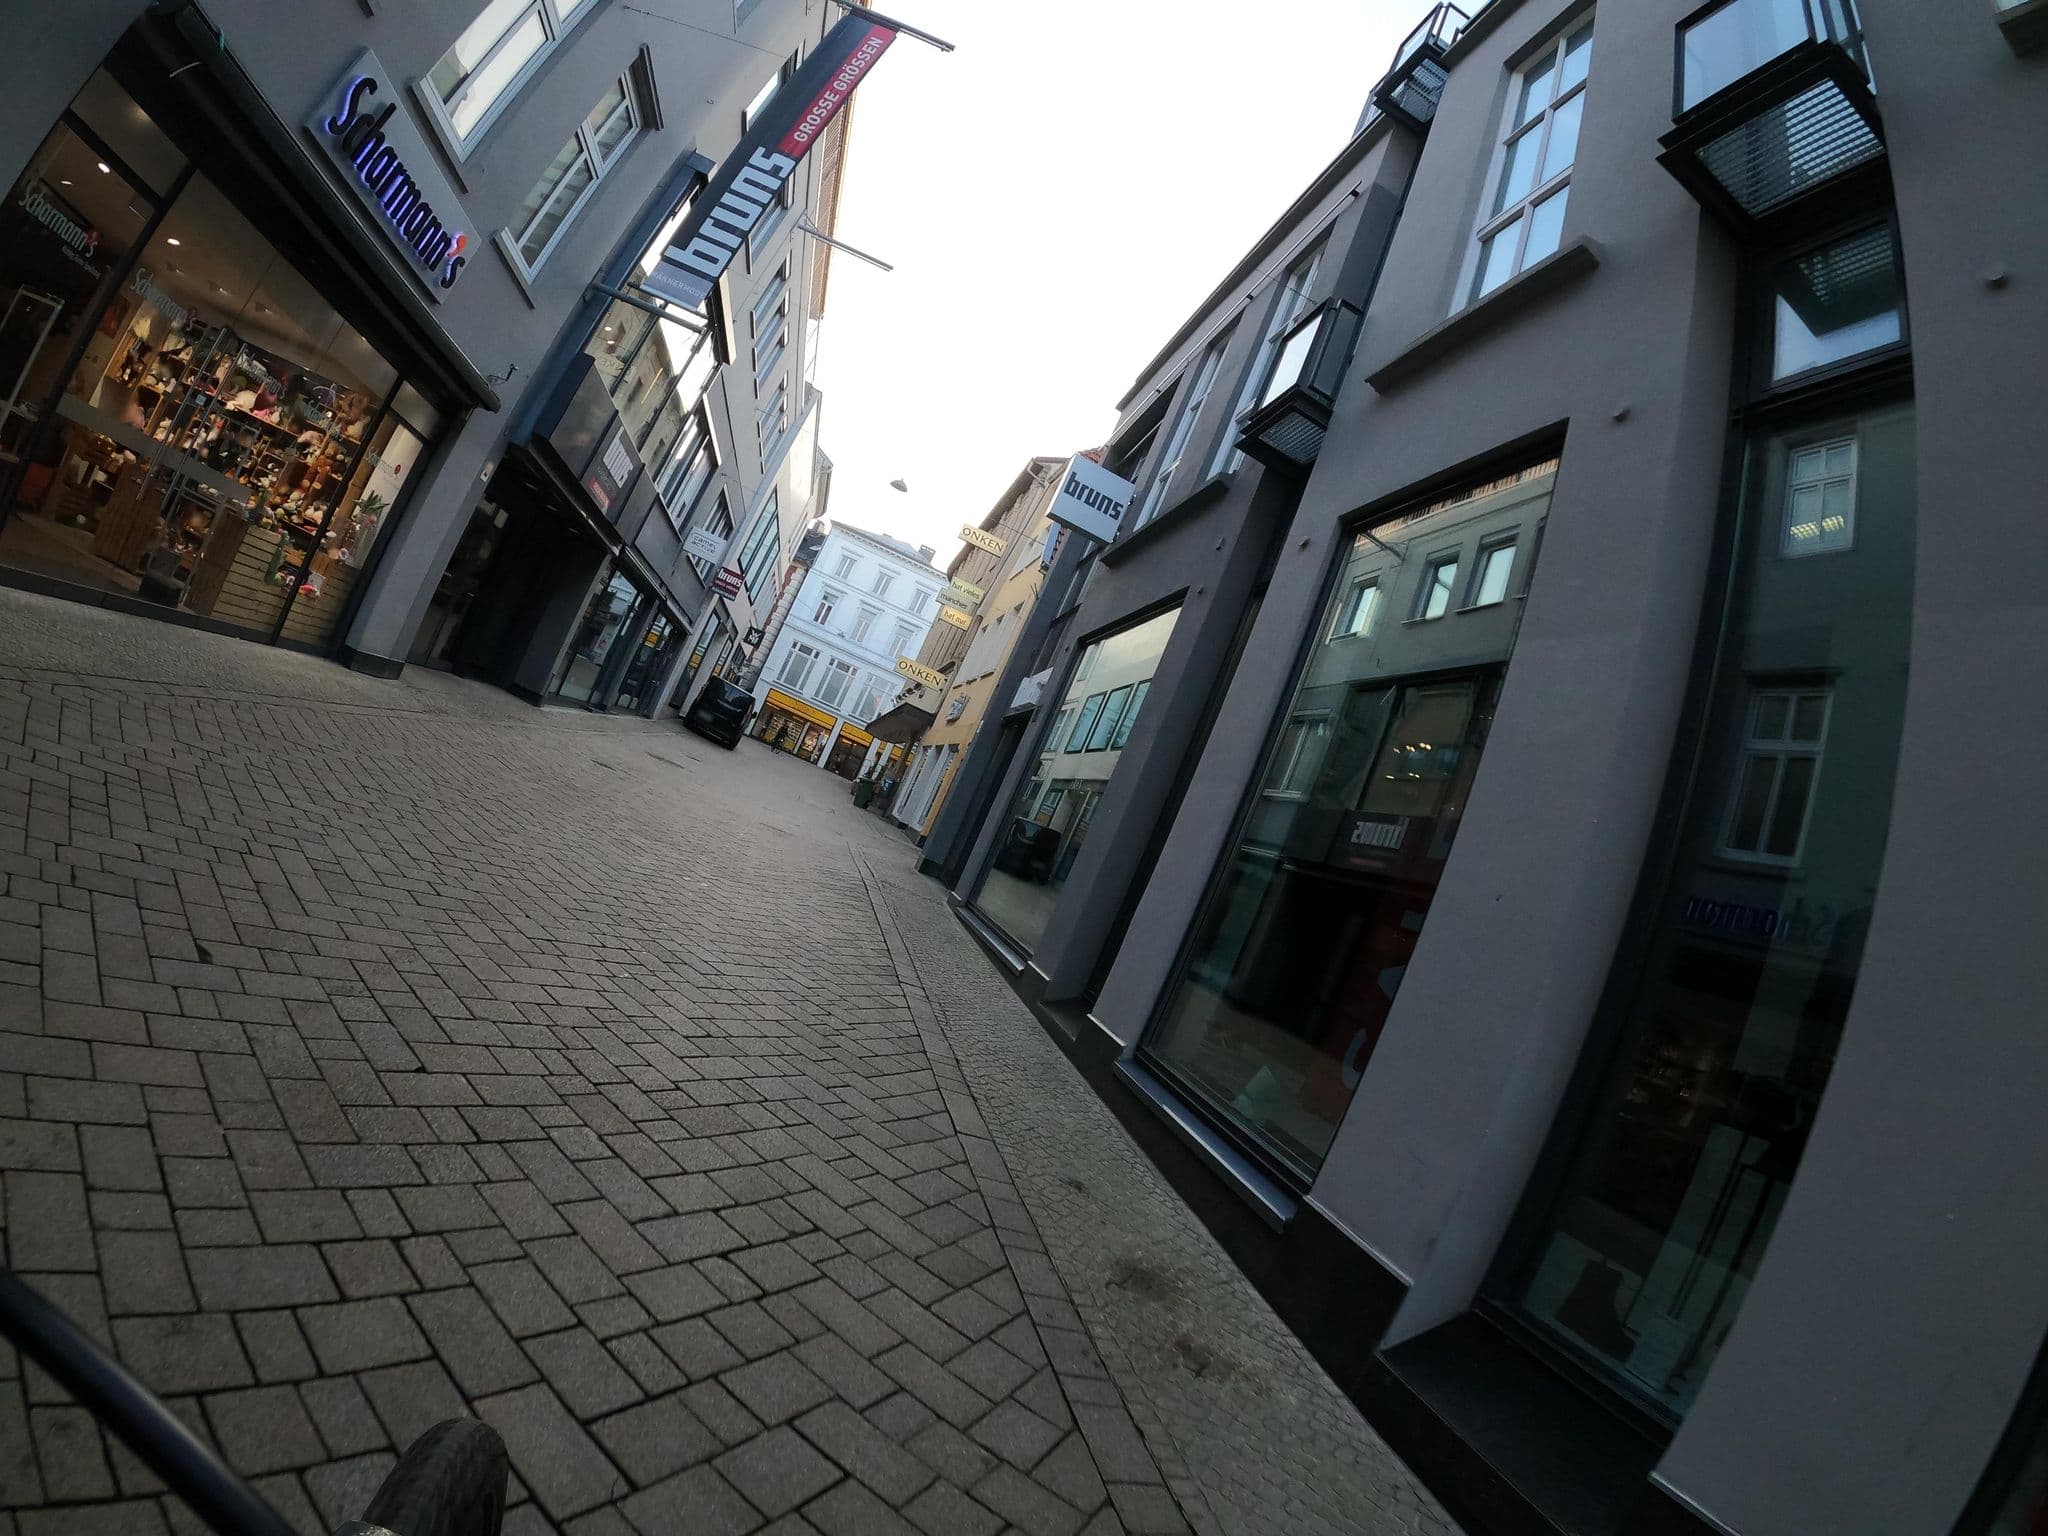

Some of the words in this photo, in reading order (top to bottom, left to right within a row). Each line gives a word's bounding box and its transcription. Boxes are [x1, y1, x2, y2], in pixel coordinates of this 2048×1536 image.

[793, 92, 839, 143] GROSSE
[832, 36, 883, 92] GRÖSSEN
[326, 77, 467, 288] Scharmann's
[663, 146, 796, 278] bruns
[1063, 471, 1124, 521] bruns
[962, 526, 1005, 552] ONKEN
[717, 568, 743, 588] bruns
[898, 660, 942, 687] ONKEN
